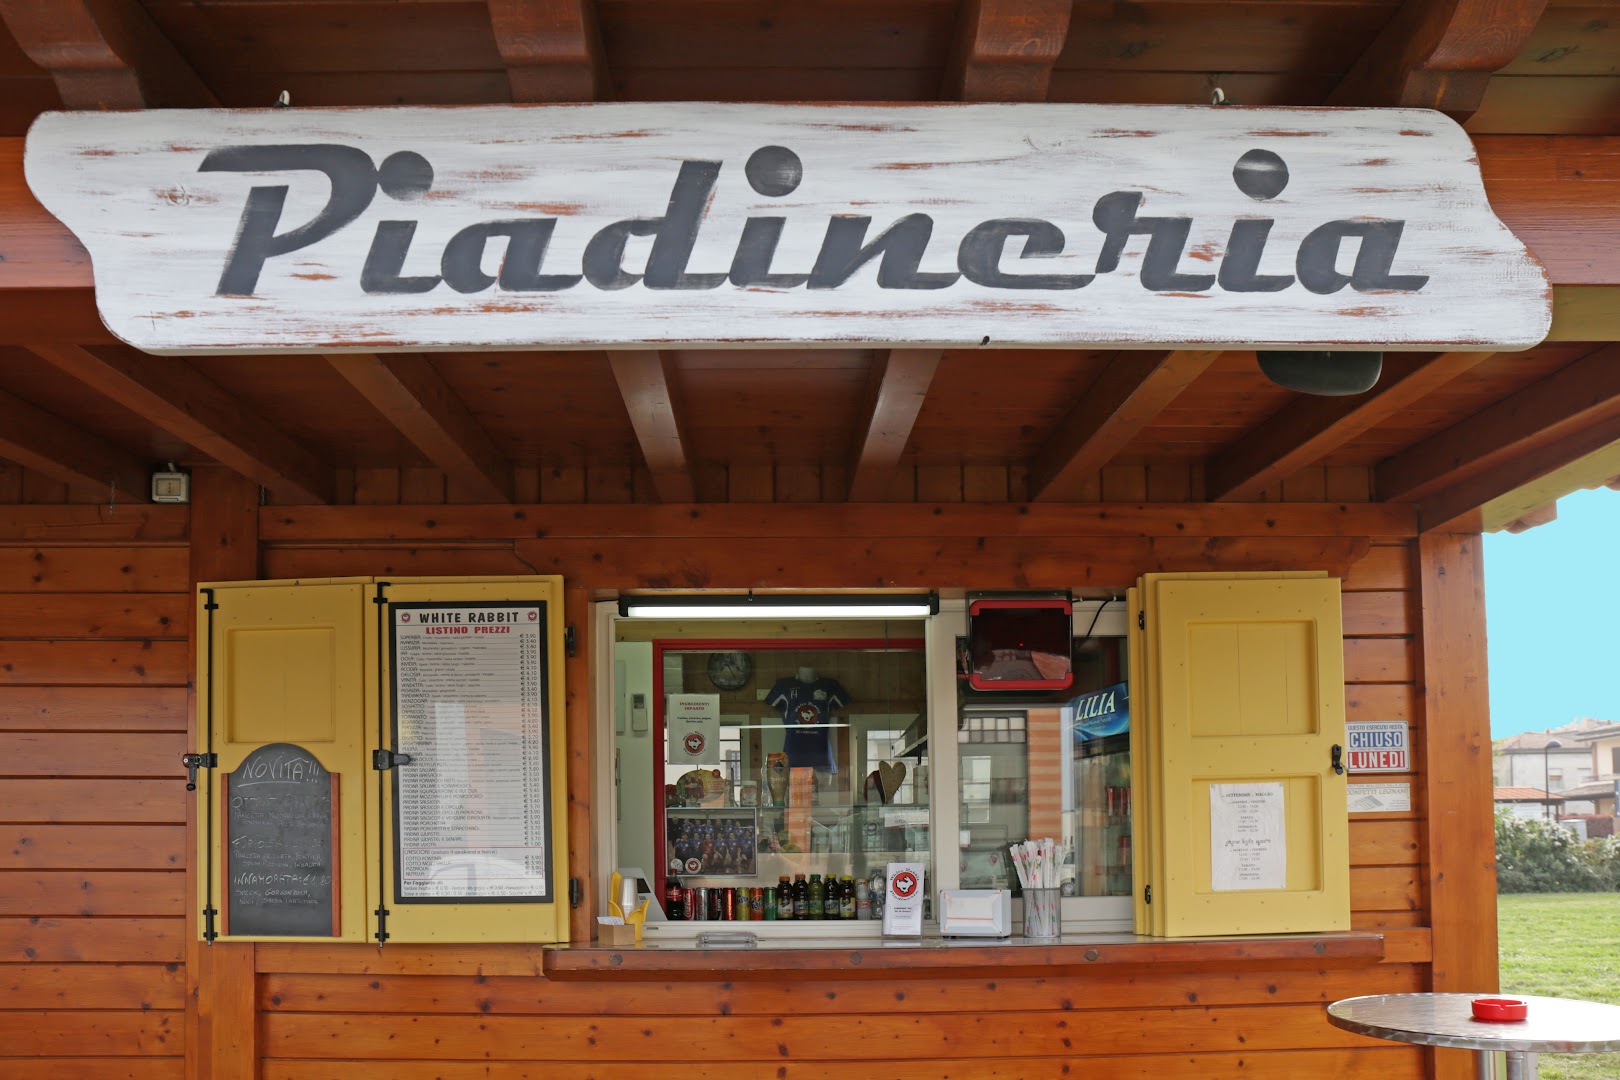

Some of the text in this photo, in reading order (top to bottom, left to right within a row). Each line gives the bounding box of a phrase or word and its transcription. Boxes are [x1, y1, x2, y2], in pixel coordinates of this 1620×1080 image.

[197, 142, 1430, 296] Piadineria
[419, 611, 519, 624] WHITE RABBIT
[425, 625, 511, 635] LISTINO PREZZI
[1075, 690, 1116, 721] LILIA
[1350, 732, 1402, 747] CHIUSO
[1349, 751, 1404, 768] LUNEDI
